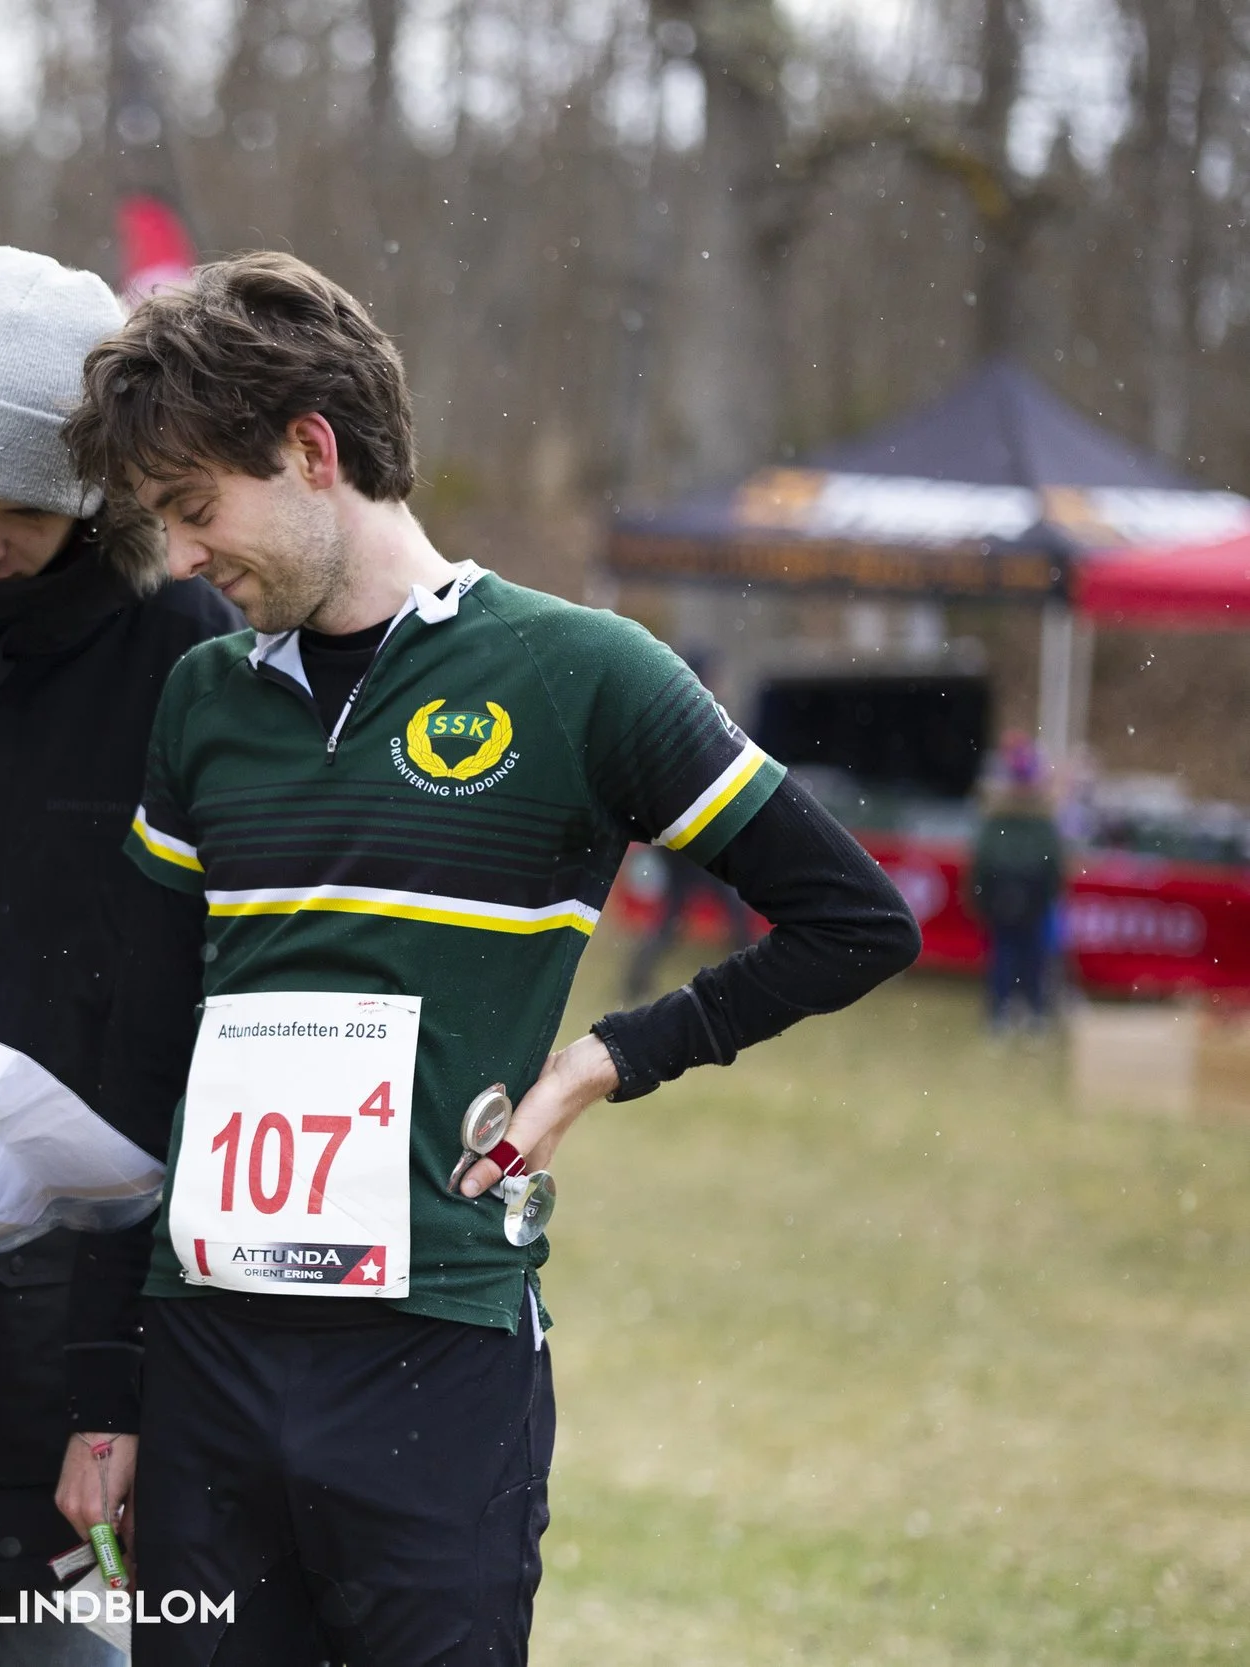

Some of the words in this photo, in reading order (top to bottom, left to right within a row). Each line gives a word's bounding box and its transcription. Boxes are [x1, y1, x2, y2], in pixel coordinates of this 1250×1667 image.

[434, 715, 489, 738] SSK
[390, 737, 450, 796] ORIENTERING
[455, 751, 520, 796] HUDDINGE
[218, 1021, 339, 1039] Attundastafetten
[345, 1023, 387, 1039] 2025
[211, 1112, 352, 1214] 107
[358, 1081, 395, 1127] 4
[232, 1246, 343, 1266] ATTUNDA
[244, 1268, 323, 1280] ORIENTERING
